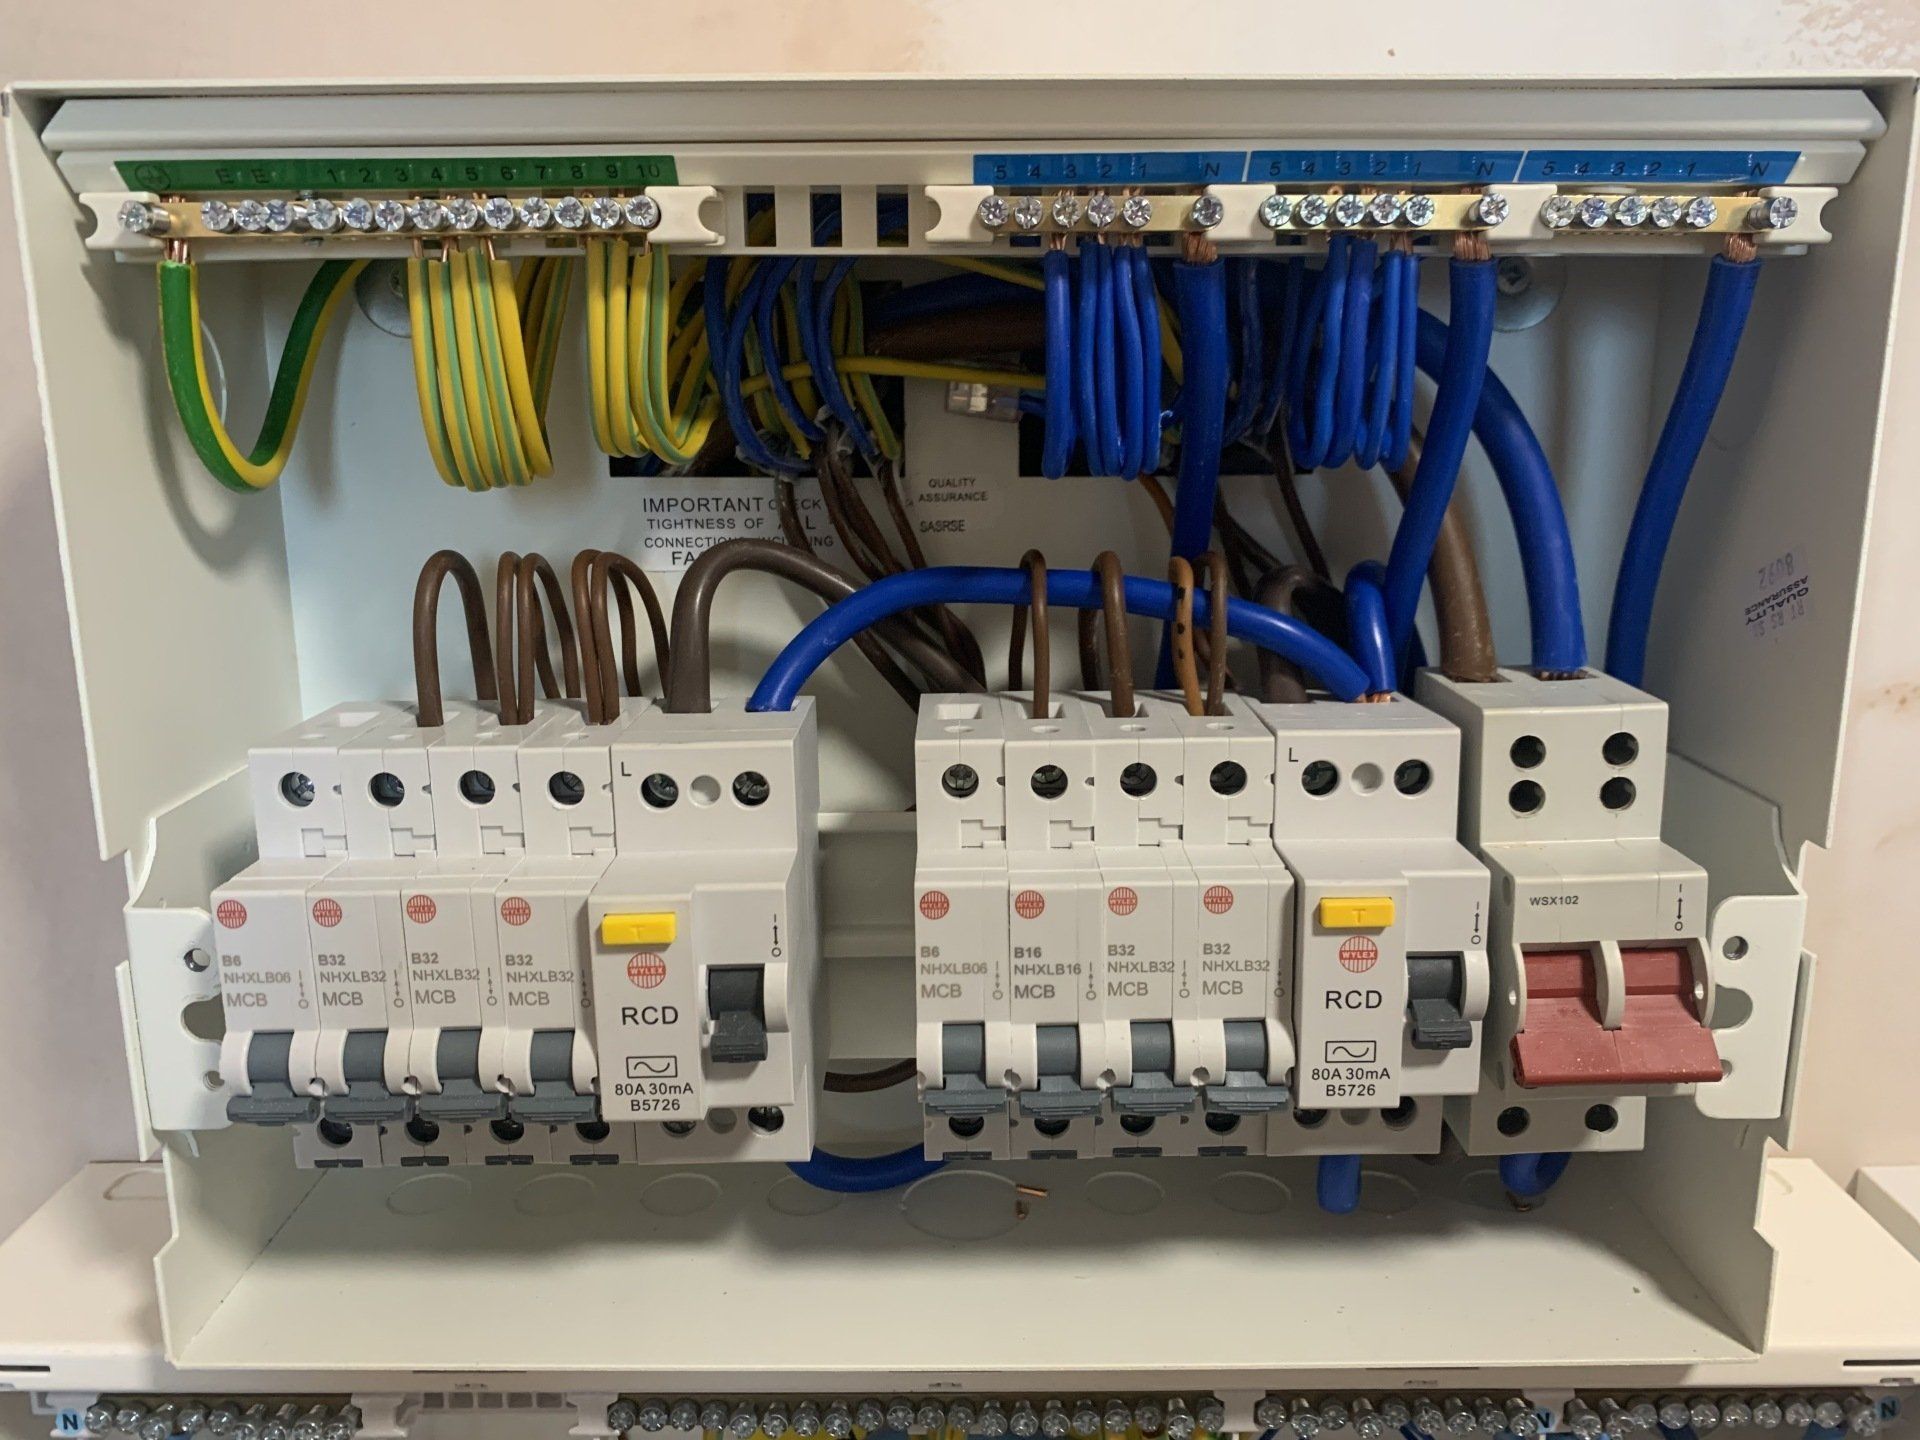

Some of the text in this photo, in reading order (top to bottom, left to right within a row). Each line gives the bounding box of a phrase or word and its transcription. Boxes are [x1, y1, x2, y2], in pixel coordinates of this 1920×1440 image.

[215, 163, 661, 184] E E 1 2 3 4 5 6 7 8 9 10
[995, 162, 1221, 180] 5 4 3 2 1 N
[1269, 161, 1494, 176] 5 4 3 2 1 N
[1542, 161, 1770, 177] 5 4 3 2 1 N
[928, 478, 976, 488] QUALITY
[919, 490, 988, 502] ASSURANCE
[642, 497, 764, 513] IMPORTANT
[646, 517, 736, 530] TIGHTNESS
[744, 517, 764, 530] OF
[1744, 575, 1808, 616] ASSURANCE
[1745, 586, 1809, 626] QUALITY
[1288, 747, 1299, 762] L
[621, 761, 632, 776] L
[1529, 895, 1579, 906] WSX102
[920, 946, 940, 958] B6
[1014, 946, 1042, 959] B16
[1107, 944, 1136, 956] B32
[1203, 943, 1231, 955] B32
[1342, 951, 1376, 959] WYLEX
[221, 955, 242, 967] B6
[318, 954, 346, 966] B32
[411, 952, 439, 964] B32
[505, 954, 533, 967] B32
[629, 966, 664, 975] WYLEX
[920, 962, 988, 975] NHXLB06
[1013, 963, 1081, 976] NHXLB16
[1107, 961, 1175, 973] NHXLB32
[1202, 960, 1270, 972] NHXLB32
[223, 971, 291, 984] NHXLB06
[320, 970, 387, 983] NHXLB32
[413, 968, 481, 981] NHXLB32
[507, 970, 574, 983] NHXLB32
[920, 984, 963, 999] MCB
[1014, 984, 1056, 999] MCB
[1107, 981, 1149, 997] MCB
[1202, 980, 1244, 996] MCB
[226, 992, 268, 1007] MCB
[322, 991, 364, 1006] MCB
[415, 989, 457, 1005] MCB
[508, 991, 550, 1006] MCB
[1325, 990, 1382, 1009] RCD
[621, 1006, 679, 1026] RCD
[1311, 1067, 1391, 1080] 80A 30mA
[614, 1082, 694, 1096] 80A 30mA
[1325, 1084, 1376, 1097] B5726
[630, 1099, 680, 1112] B5726
[1880, 1400, 1896, 1419] N
[62, 1413, 78, 1430] N
